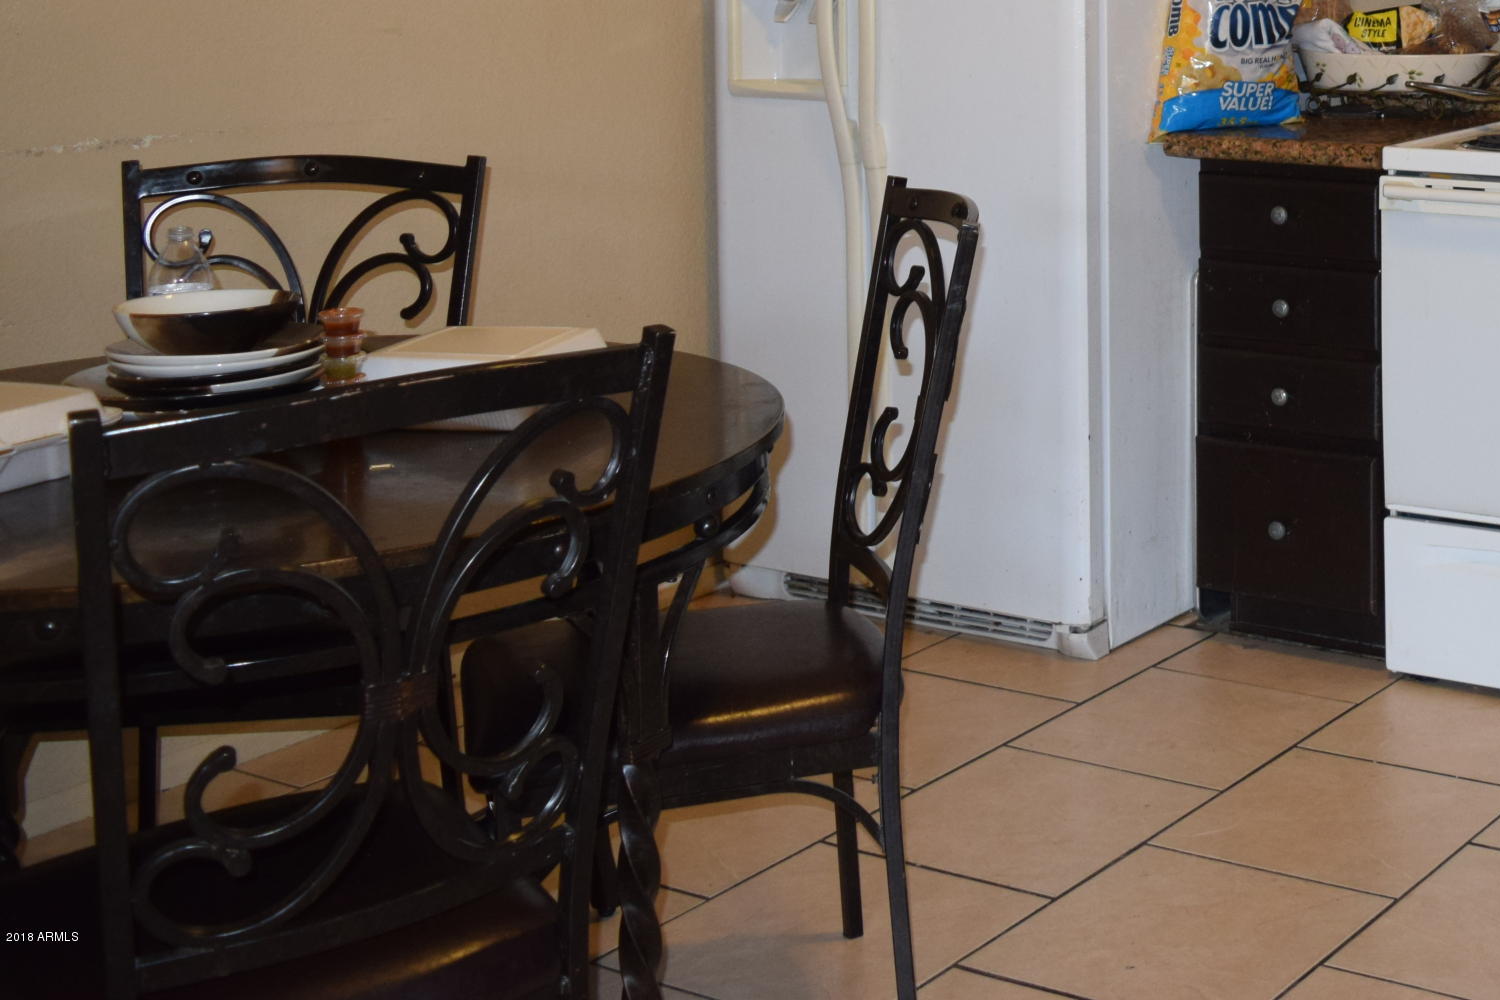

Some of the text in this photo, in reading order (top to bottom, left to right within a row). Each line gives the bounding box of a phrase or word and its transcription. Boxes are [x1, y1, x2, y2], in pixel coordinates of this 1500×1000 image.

[1353, 16, 1392, 29] CINEMA
[1361, 28, 1388, 39] STYLE
[1240, 57, 1254, 65] BIG
[1221, 81, 1275, 97] SUPER
[1219, 95, 1274, 111] VALUE!
